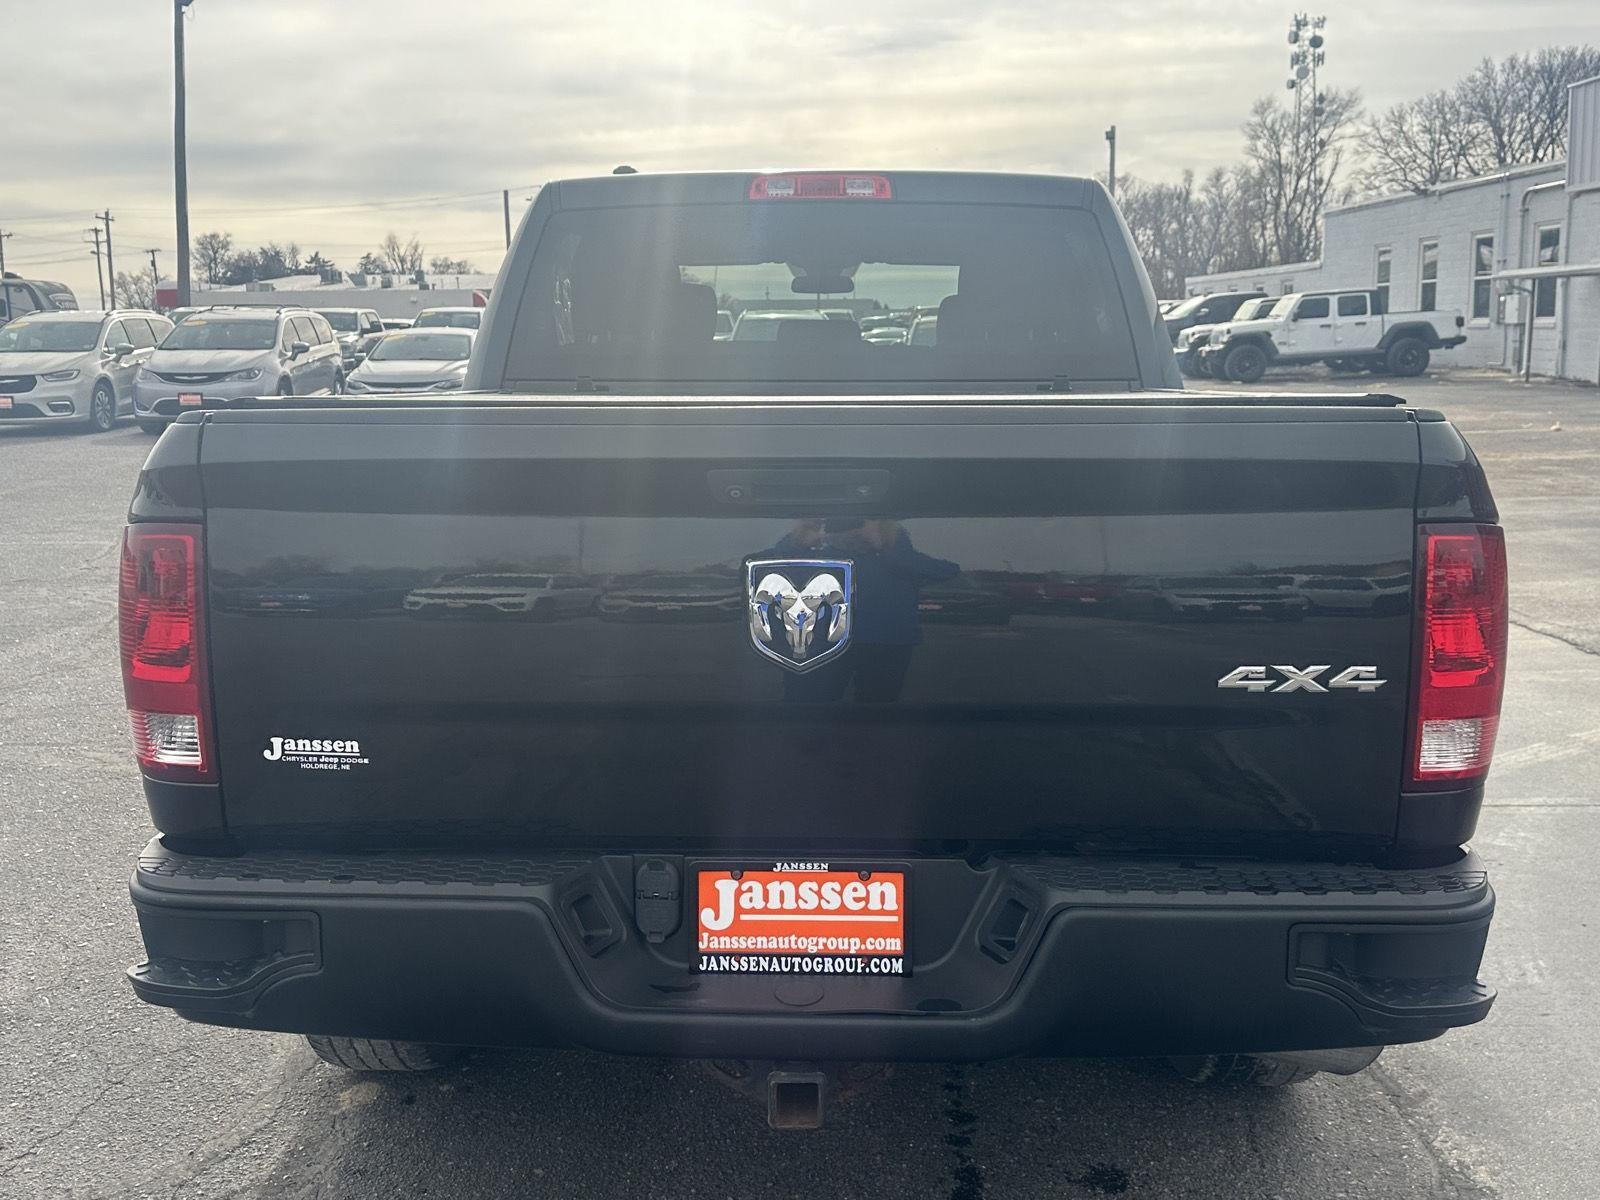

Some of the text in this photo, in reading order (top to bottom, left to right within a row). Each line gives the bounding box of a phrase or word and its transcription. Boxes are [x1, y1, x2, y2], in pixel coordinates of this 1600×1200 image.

[1217, 664, 1388, 693] 4X4
[263, 737, 360, 761] Janssen
[281, 755, 318, 763] CHRYSLER
[319, 755, 339, 764] Jeep
[300, 763, 340, 771] HOLDREGE,
[773, 862, 829, 873] JANSSEN
[700, 879, 899, 931] Janssen
[699, 932, 902, 954] Janssenautogroup.com
[699, 955, 904, 974] JANSSENAUTOGROUP.COM
